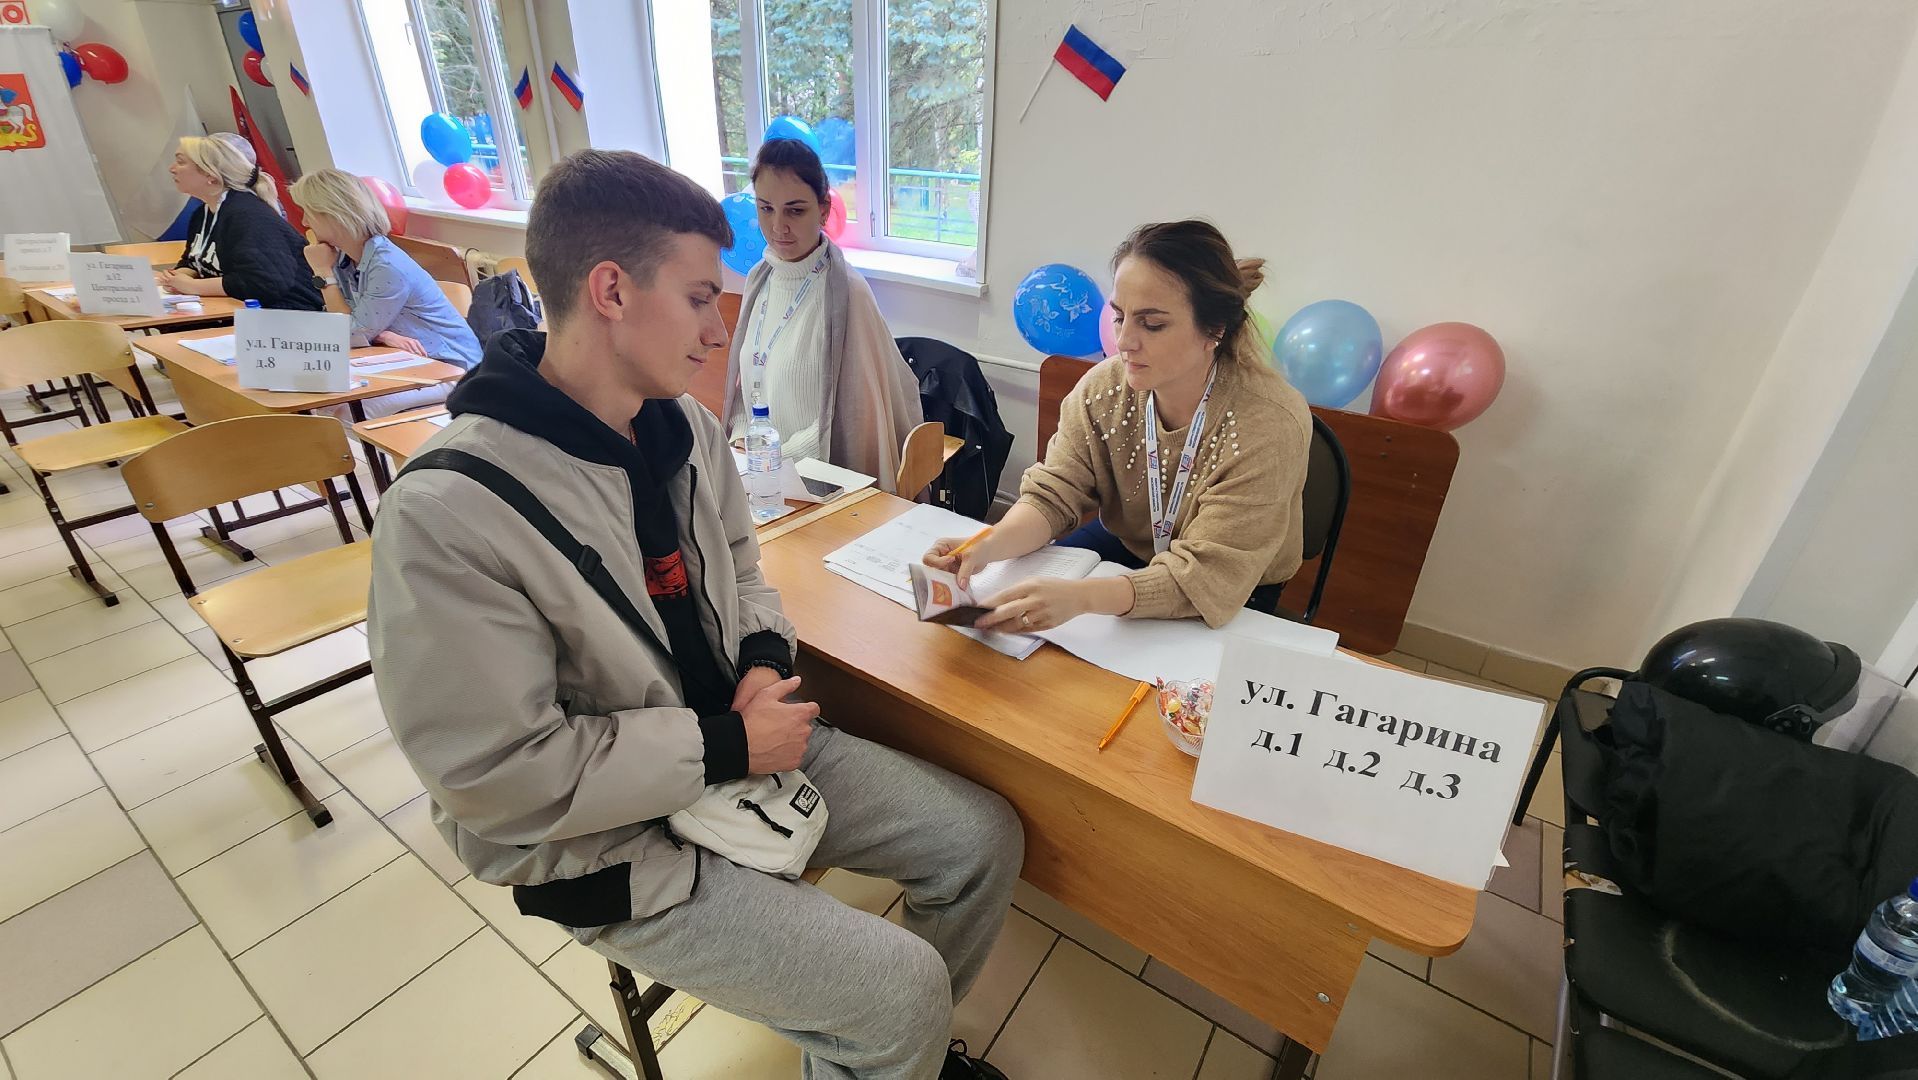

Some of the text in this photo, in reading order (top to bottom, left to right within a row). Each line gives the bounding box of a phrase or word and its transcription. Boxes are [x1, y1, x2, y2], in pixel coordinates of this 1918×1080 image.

[246, 337, 340, 353] ул. Гагарина
[256, 356, 331, 371] д.8 д.10
[1240, 679, 1503, 763] ул. Гагарина
[1250, 729, 1462, 800] д.1 д.2 д.3
